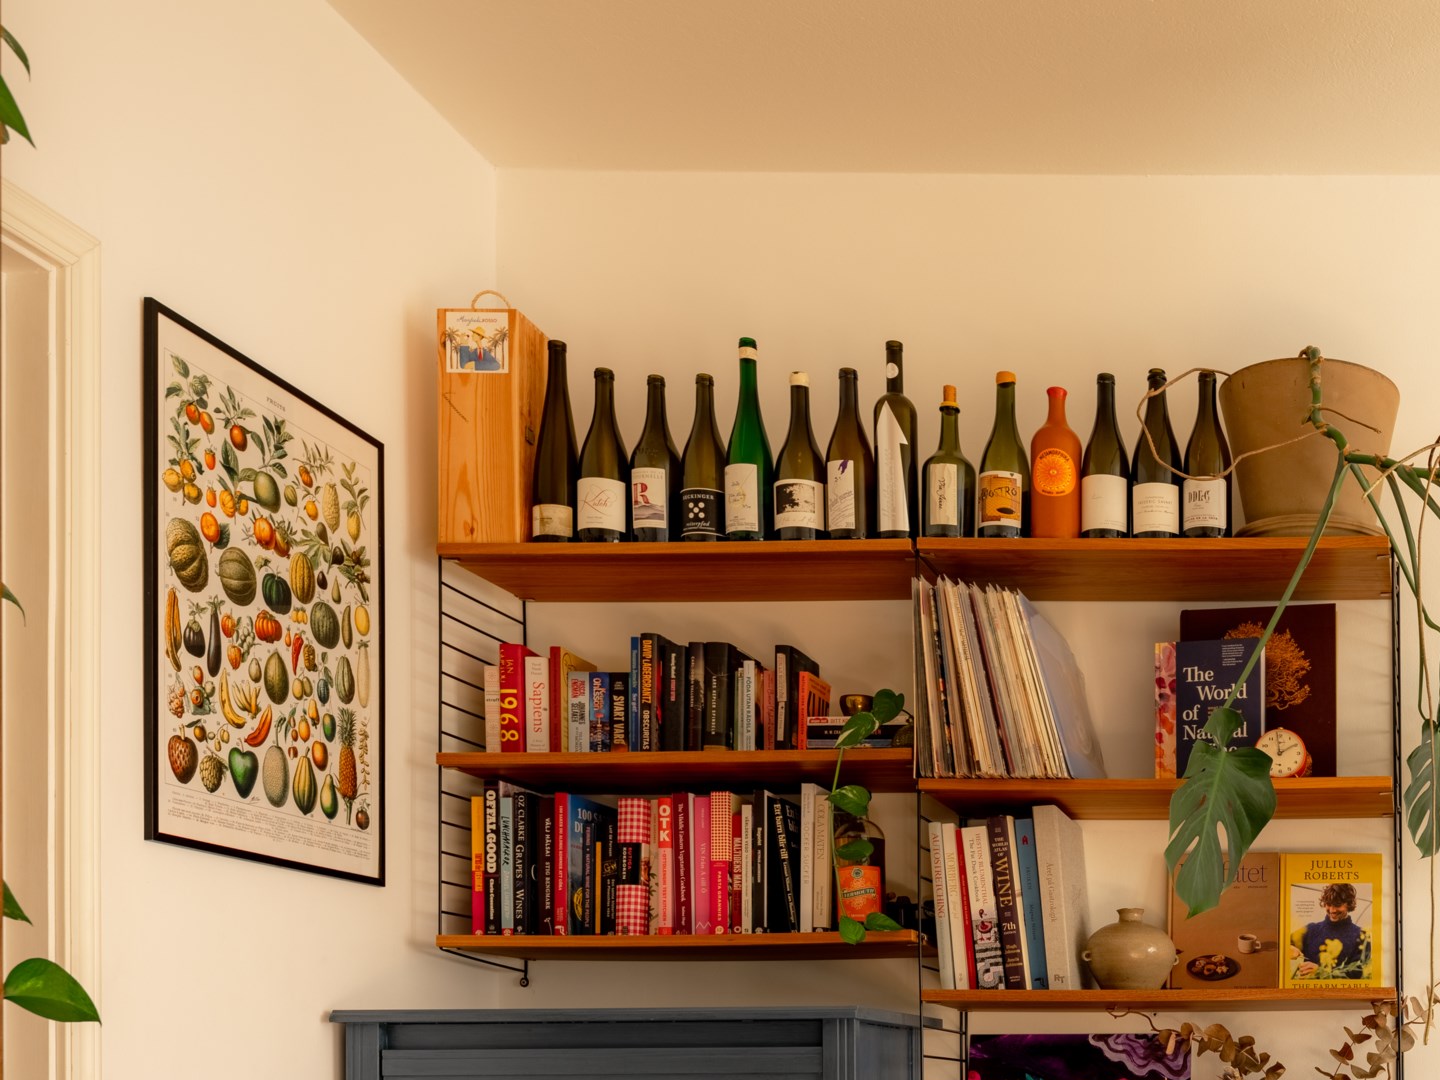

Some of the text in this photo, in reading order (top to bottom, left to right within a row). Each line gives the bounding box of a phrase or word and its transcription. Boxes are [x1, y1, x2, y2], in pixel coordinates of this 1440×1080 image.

[266, 396, 286, 412] FRUITS
[632, 482, 650, 506] R
[505, 658, 515, 674] JAN
[642, 640, 653, 704] DAVID LAGERCRANTZ
[1182, 665, 1215, 684] The
[1196, 682, 1248, 702] World
[500, 688, 519, 742] 1968
[529, 682, 548, 734] Sapiens
[612, 695, 625, 722] SVART
[1182, 704, 1200, 721] of
[613, 723, 627, 745] VARG
[642, 709, 650, 750] OBSCURITAS
[517, 795, 525, 808] OZ
[576, 807, 592, 822] 100
[773, 804, 782, 816] Ett
[485, 790, 498, 873] OFFAL GOOD
[517, 809, 525, 842] CLARKE
[659, 804, 671, 842] OTK
[775, 816, 783, 834] barn
[803, 821, 811, 852] SOCKER
[778, 834, 786, 848] blir
[817, 828, 825, 861] MATEN
[515, 844, 525, 879] GRAPES
[678, 850, 686, 877] Vegetarian
[803, 854, 811, 885] SUCKER
[976, 833, 989, 906] HESTON BLUMENTHAL
[1310, 859, 1354, 871] JULIUS
[733, 873, 742, 891] MAGI
[931, 833, 946, 919] AUTOSTRETCHING
[973, 876, 981, 903] Cookbook
[995, 856, 1013, 907] WINE
[1304, 871, 1360, 881] ROBERTS
[515, 889, 525, 920] WINES
[1002, 921, 1016, 931] 7th
